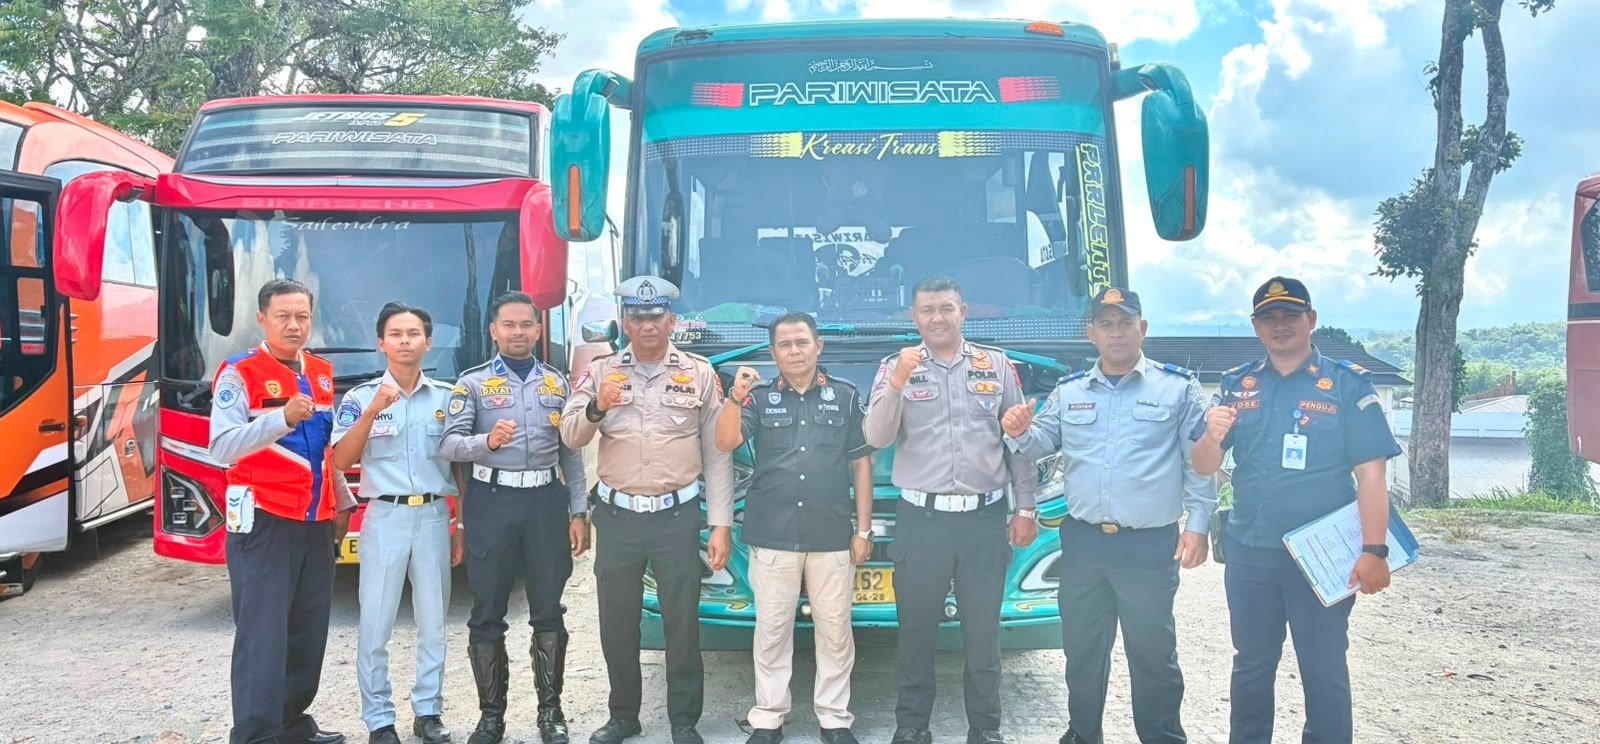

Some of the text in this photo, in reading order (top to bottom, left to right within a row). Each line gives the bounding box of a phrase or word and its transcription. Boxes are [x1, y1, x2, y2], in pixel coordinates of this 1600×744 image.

[748, 80, 996, 106] PARIWISATA
[272, 132, 438, 145] PARIWISATA
[800, 133, 939, 160] Kreasi Trans
[281, 216, 411, 231] Sailendra
[677, 332, 702, 341] 7753
[967, 370, 998, 379] POLRI
[482, 387, 511, 395] DAYAT
[665, 385, 696, 394] POLRI
[1300, 402, 1336, 413] PENGUJI
[350, 539, 358, 554] E
